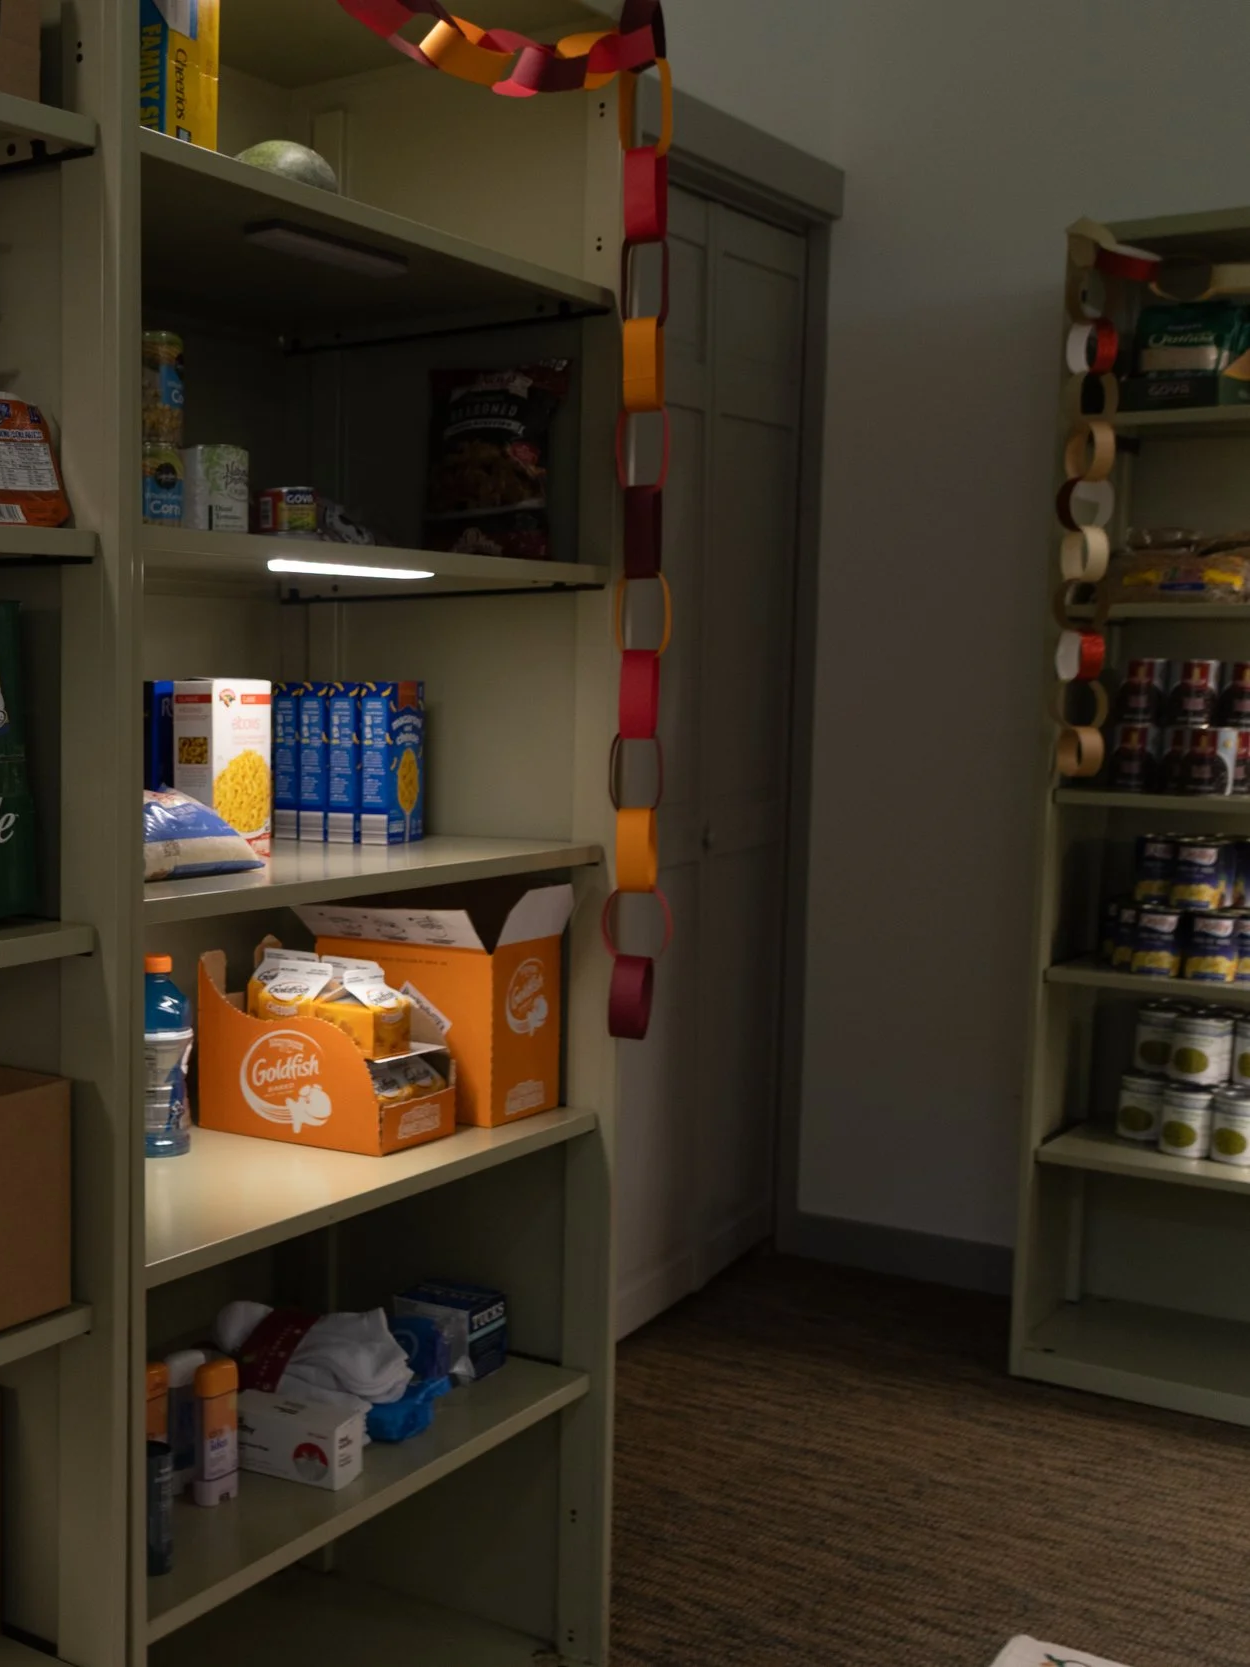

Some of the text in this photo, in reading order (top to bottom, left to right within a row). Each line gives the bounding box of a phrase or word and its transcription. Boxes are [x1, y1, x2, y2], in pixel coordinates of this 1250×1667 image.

[141, 23, 162, 131] FAMILY SI
[175, 47, 188, 121] Cheerios
[149, 500, 182, 516] Corn
[286, 493, 314, 504] GOYA
[267, 983, 310, 996] Goldfish
[252, 1053, 320, 1087] Goldfish
